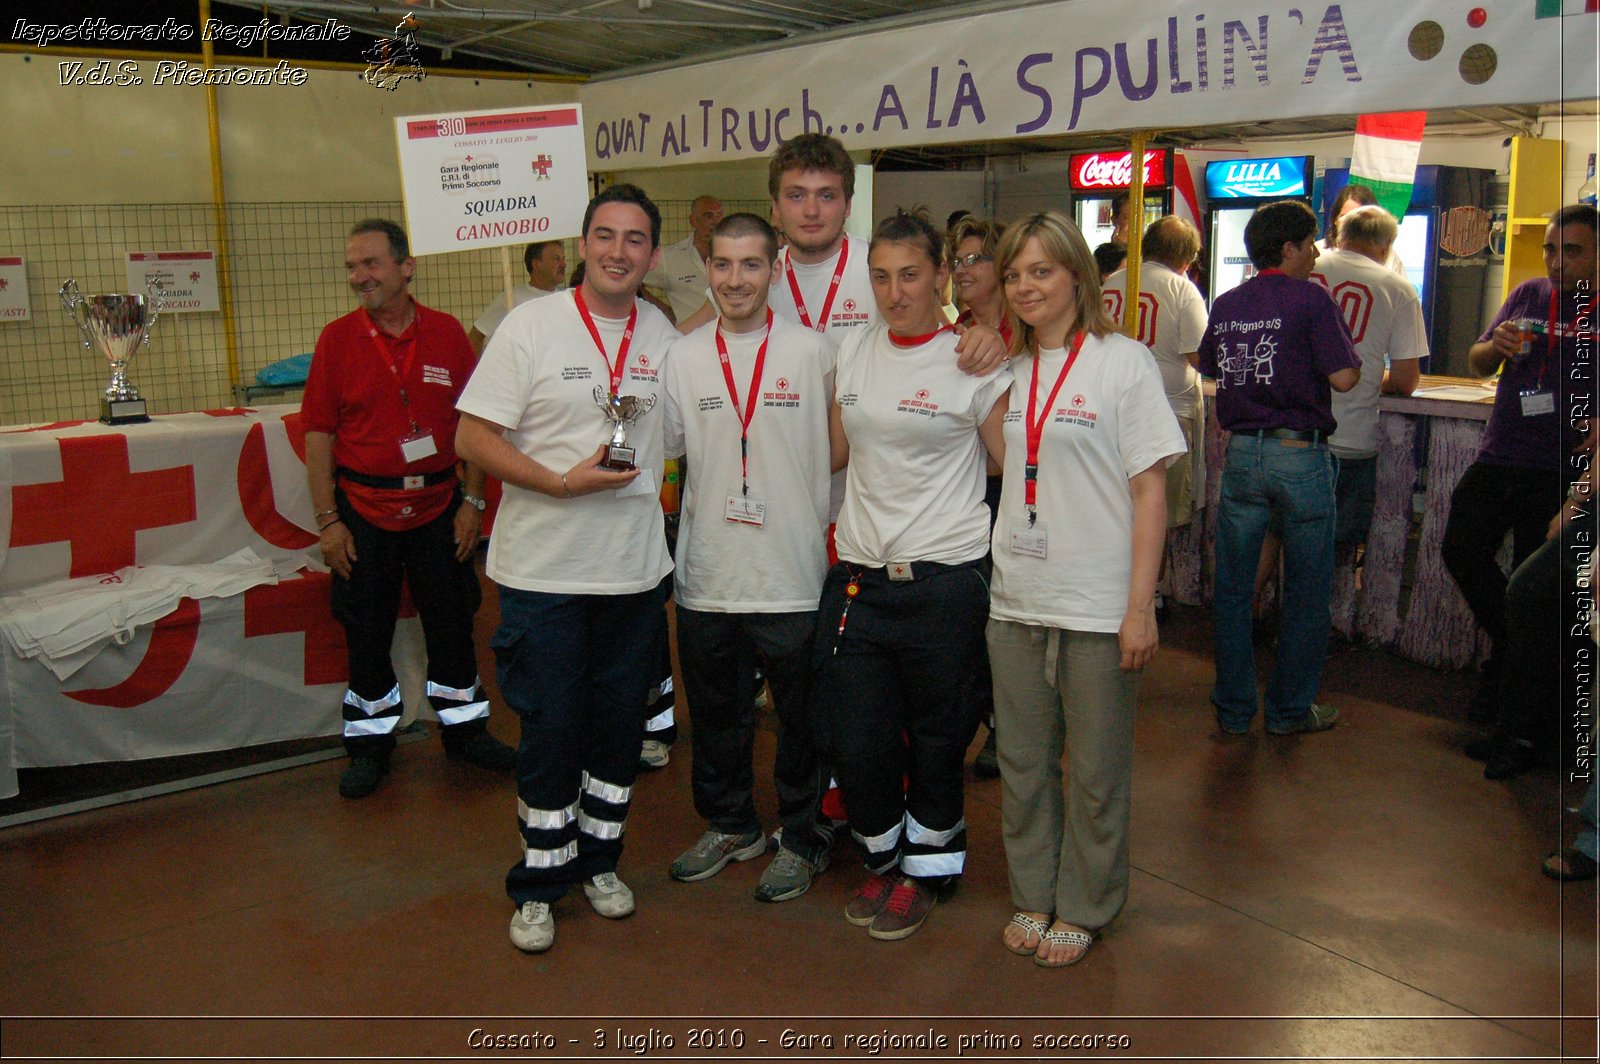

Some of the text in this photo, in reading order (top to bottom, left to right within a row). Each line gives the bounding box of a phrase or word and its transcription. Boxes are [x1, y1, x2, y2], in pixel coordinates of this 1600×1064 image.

[595, 112, 651, 160] QUAT
[660, 113, 691, 158] AL
[440, 162, 500, 174] Gara Regionale
[441, 173, 461, 182] C.R.I.
[1225, 162, 1281, 183] LILIA
[442, 179, 501, 191] Primo Soccorso
[464, 195, 538, 217] SQUADRA
[456, 216, 550, 242] CANNOBIO
